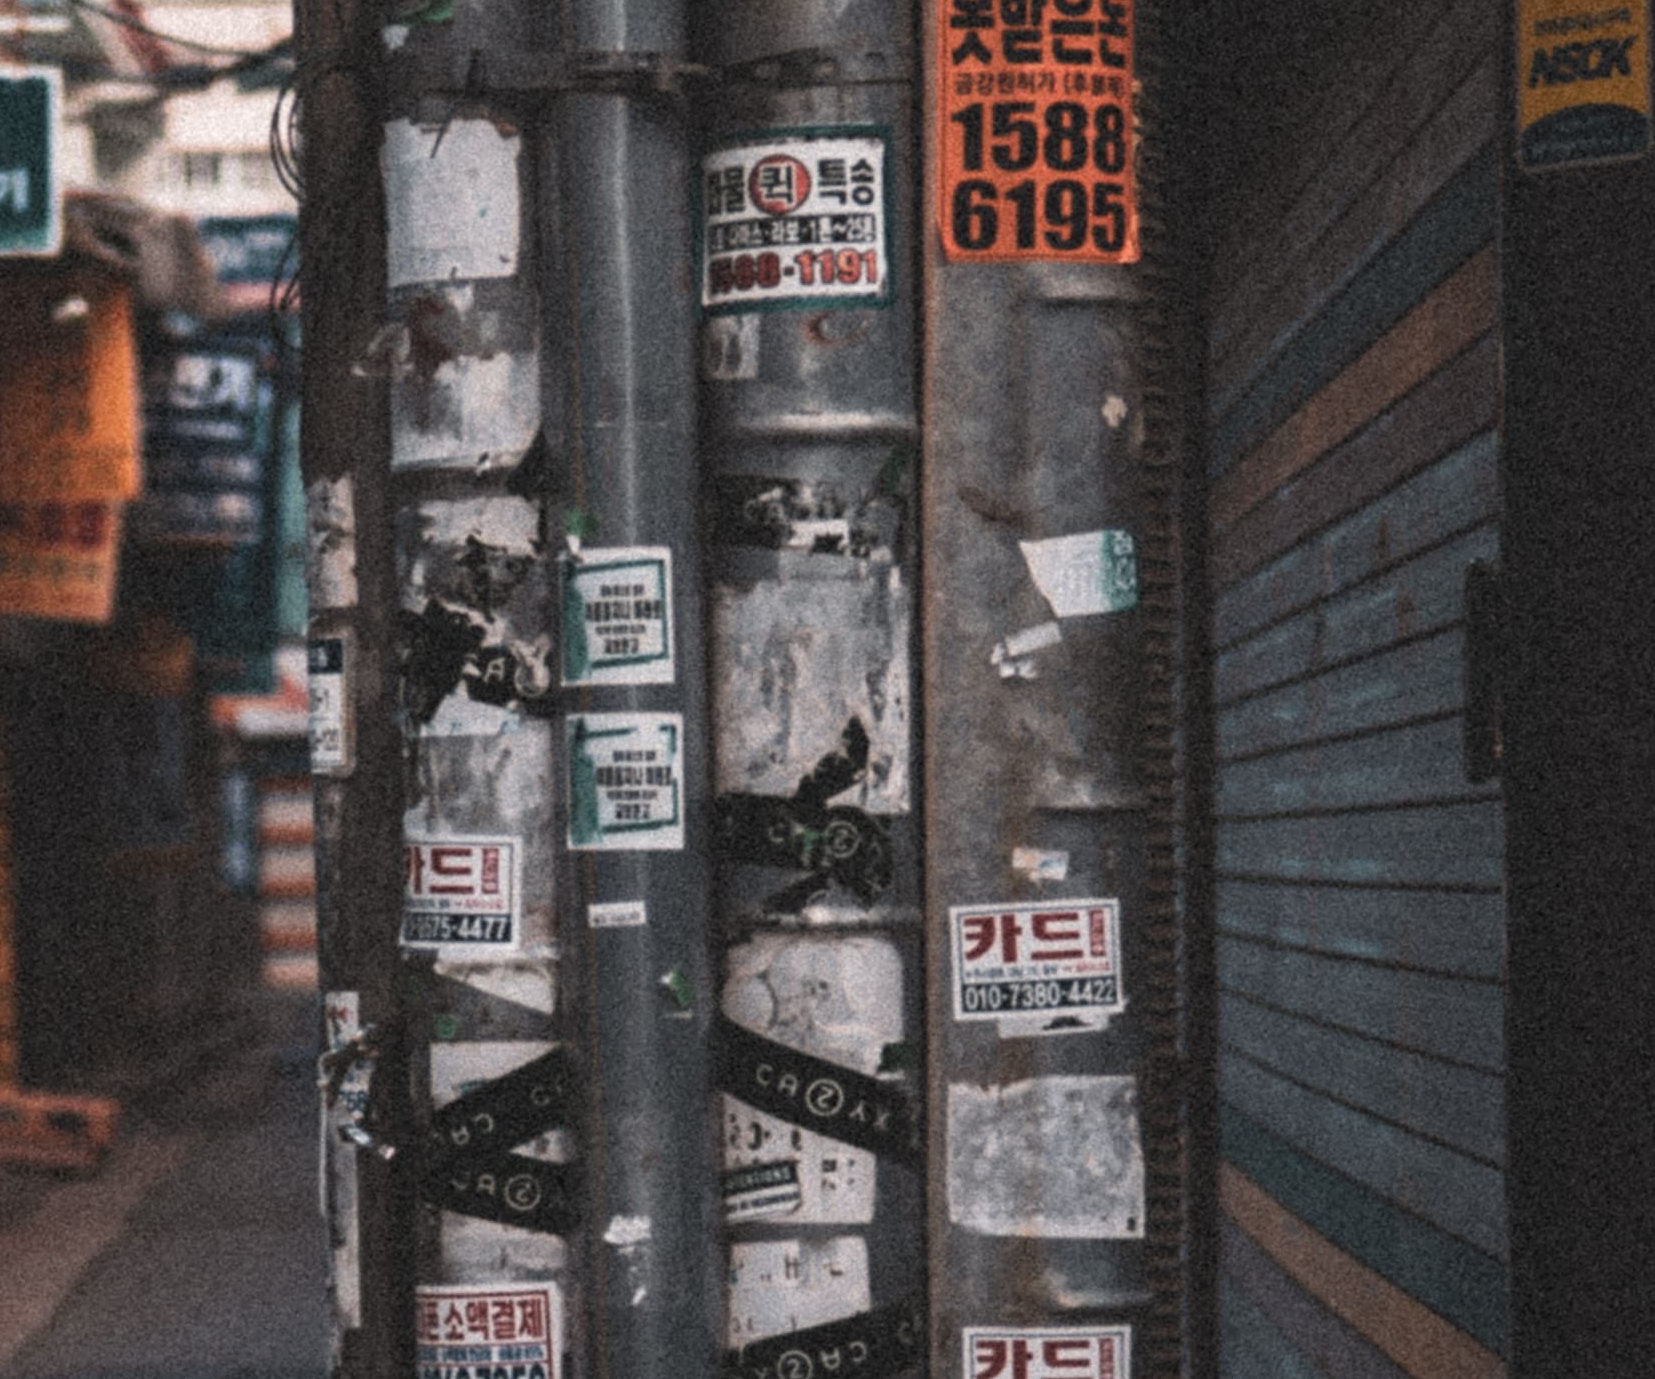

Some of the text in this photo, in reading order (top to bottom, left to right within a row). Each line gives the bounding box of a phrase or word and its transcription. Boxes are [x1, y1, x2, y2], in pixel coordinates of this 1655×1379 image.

[951, 102, 1126, 174] 1588
[952, 179, 1127, 252] 6195
[964, 912, 1084, 963] 카드
